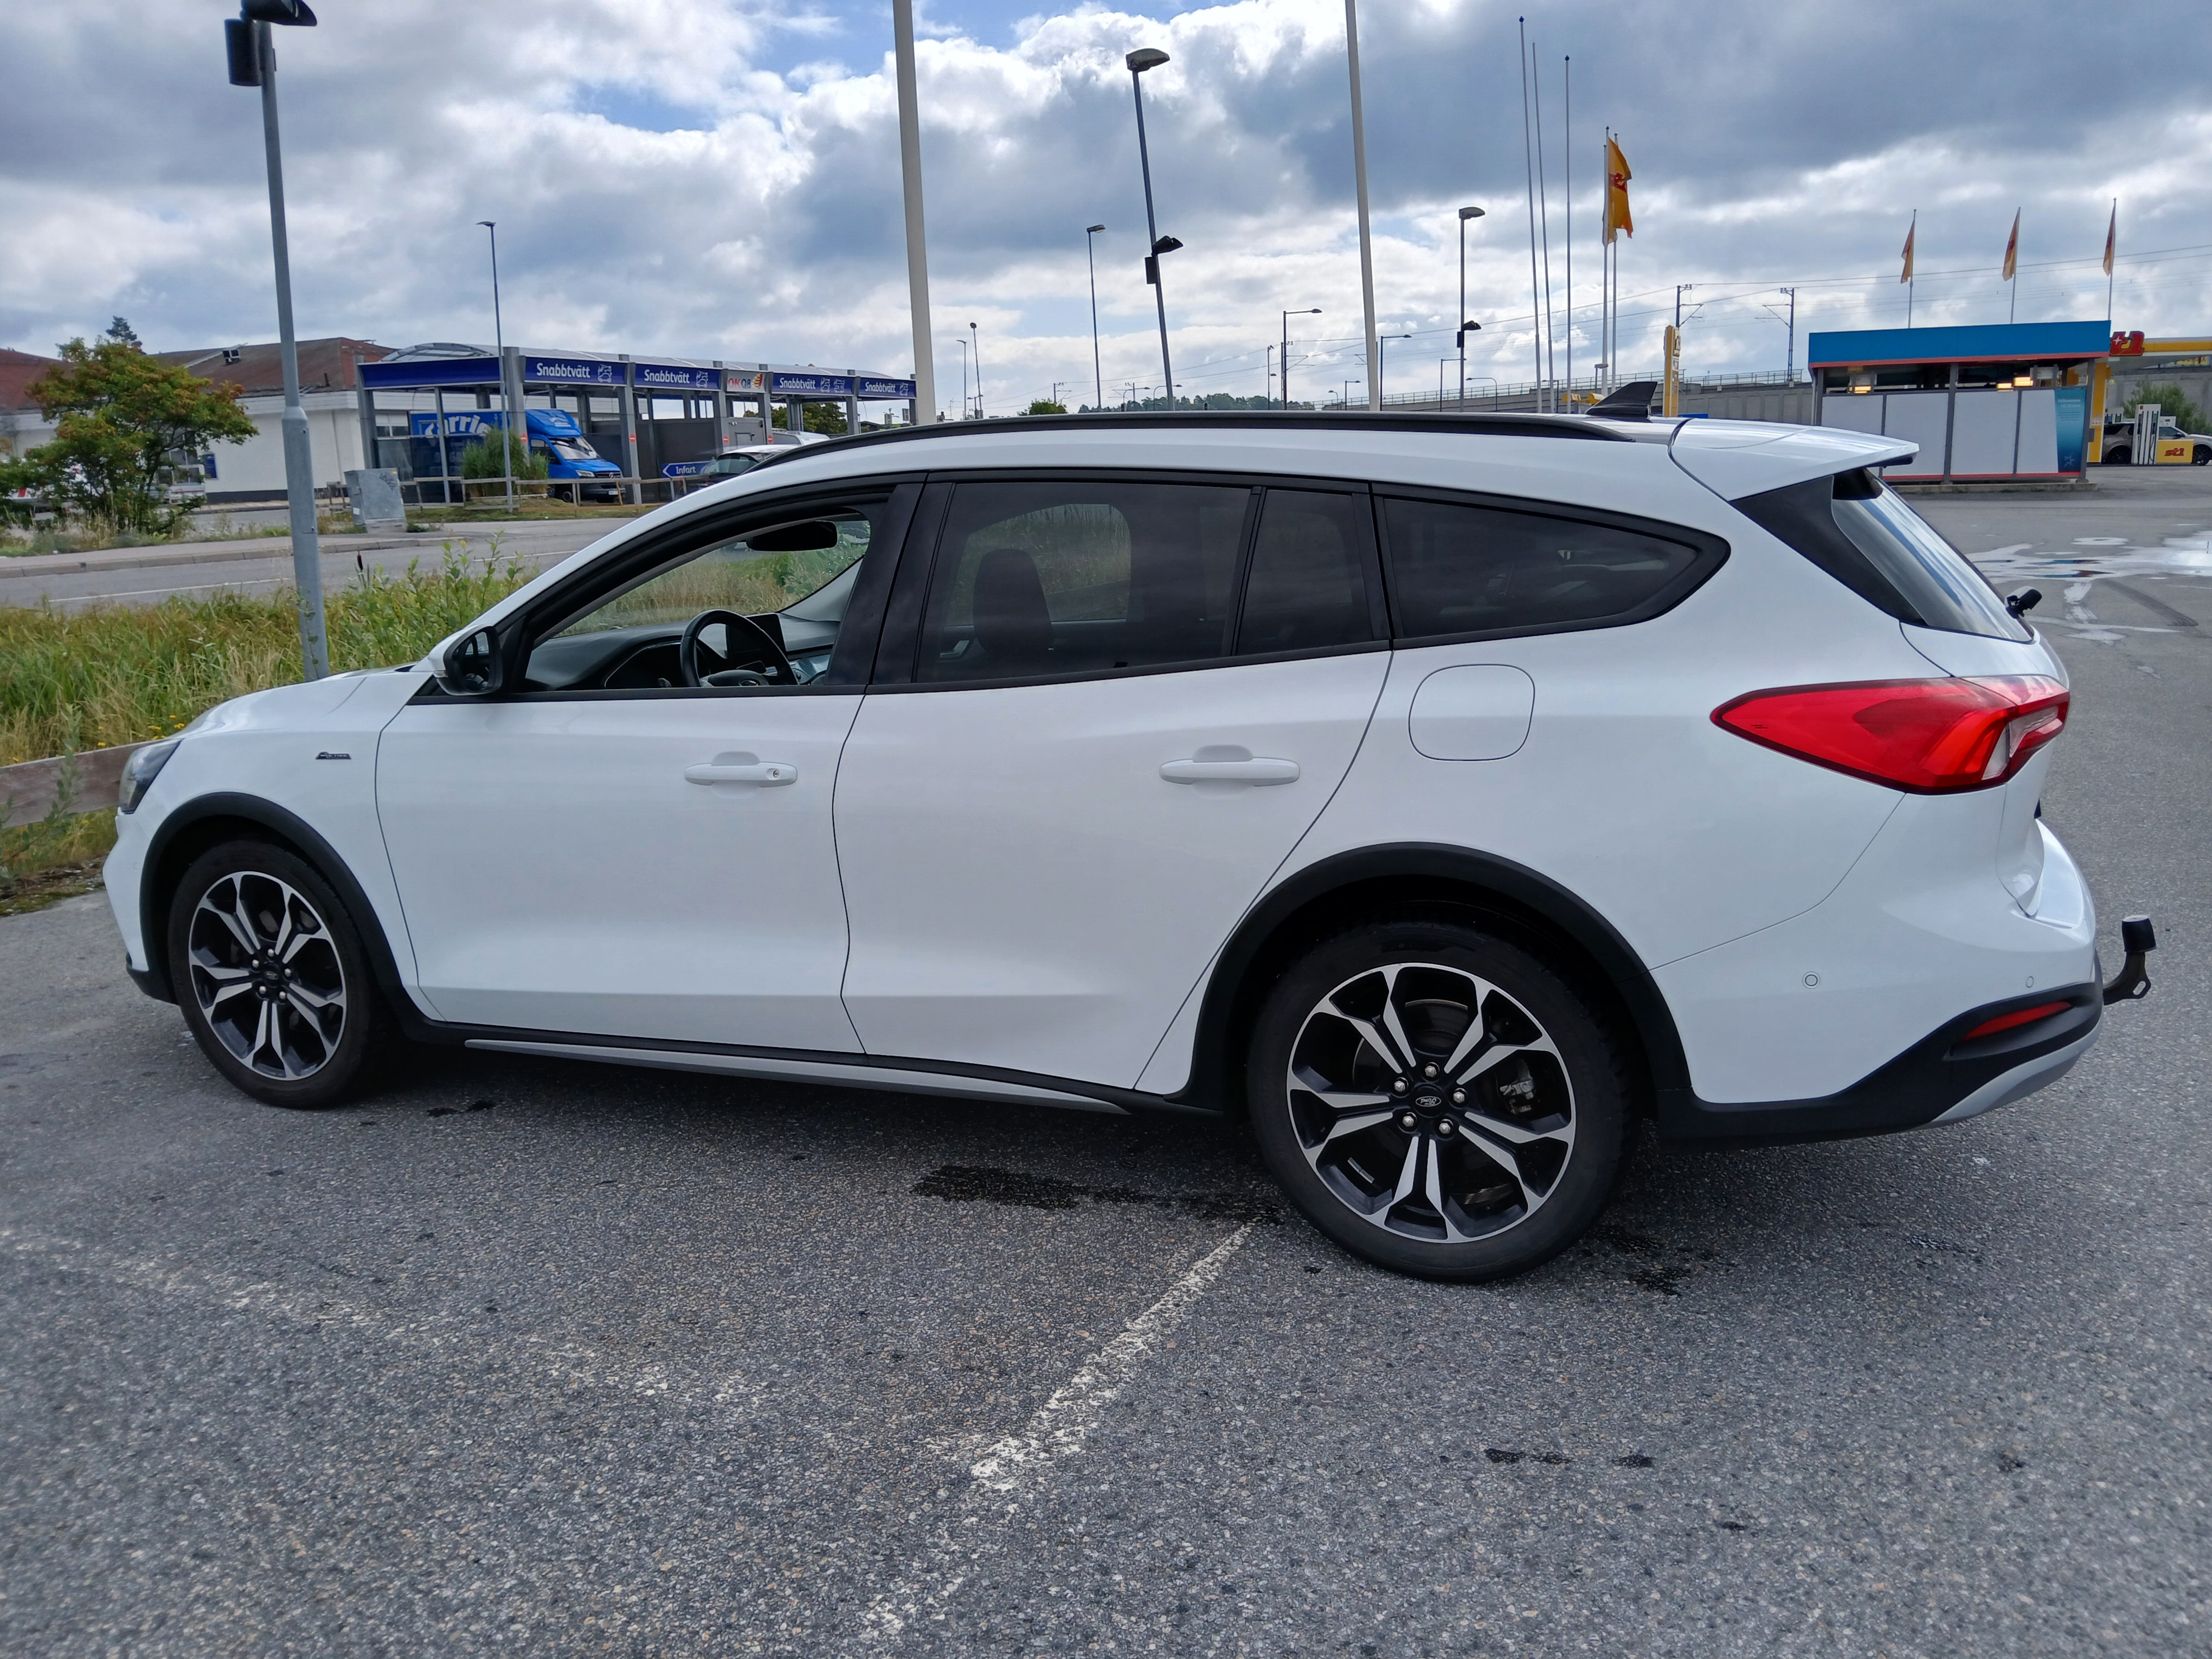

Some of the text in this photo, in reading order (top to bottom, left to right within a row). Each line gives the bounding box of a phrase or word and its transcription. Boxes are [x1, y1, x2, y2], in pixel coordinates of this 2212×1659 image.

[536, 363, 590, 378] Snabbtvätt
[644, 369, 690, 384] Snabbtvätt
[728, 378, 751, 389] OKQ8
[780, 377, 816, 389] Snabbtvätt
[865, 382, 896, 393] Snabbtvätt
[676, 466, 696, 474] Infart
